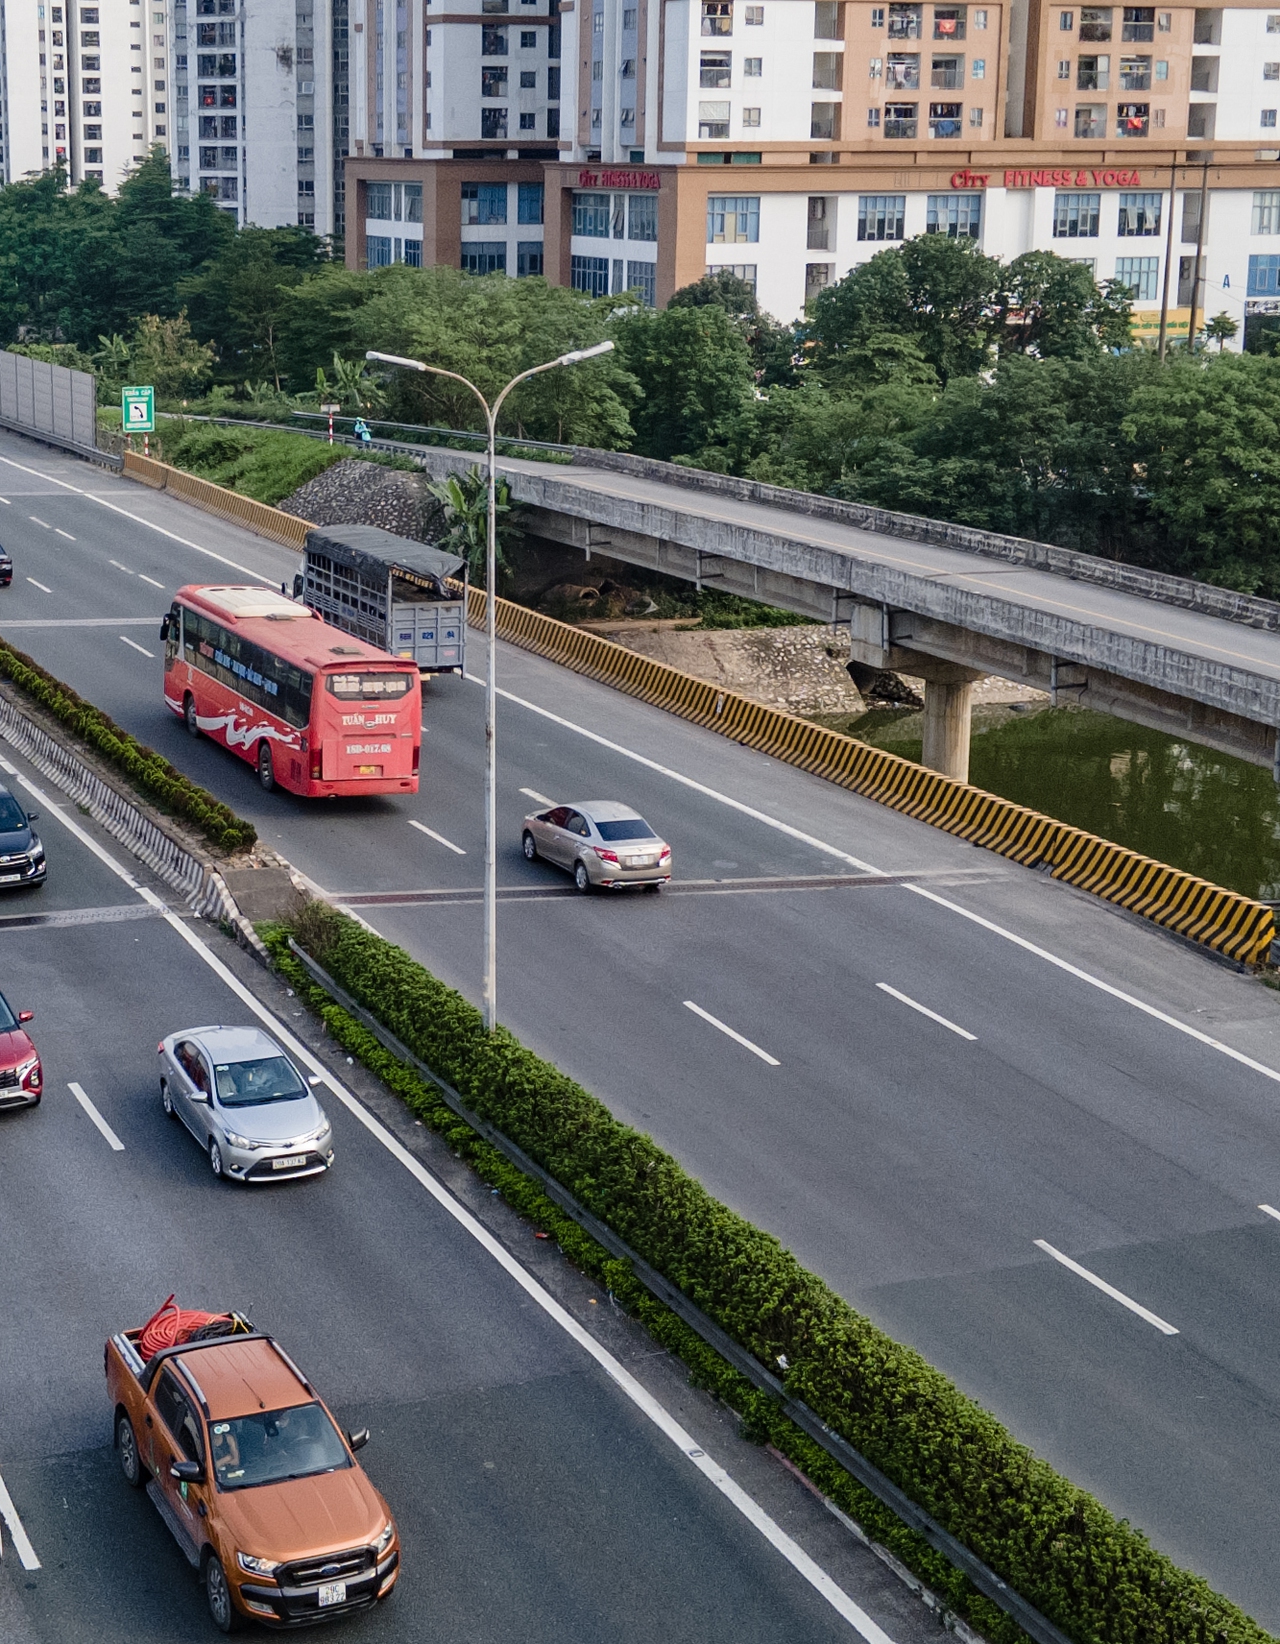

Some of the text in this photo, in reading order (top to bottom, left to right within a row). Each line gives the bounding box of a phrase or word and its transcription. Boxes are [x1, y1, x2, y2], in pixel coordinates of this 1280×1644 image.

[637, 171, 661, 188] YOGA
[1004, 170, 1072, 187] FITNESS
[1075, 170, 1088, 186] &
[1091, 169, 1141, 186] YOGA
[1222, 274, 1231, 289] A
[341, 712, 398, 726] TUẤN HUY
